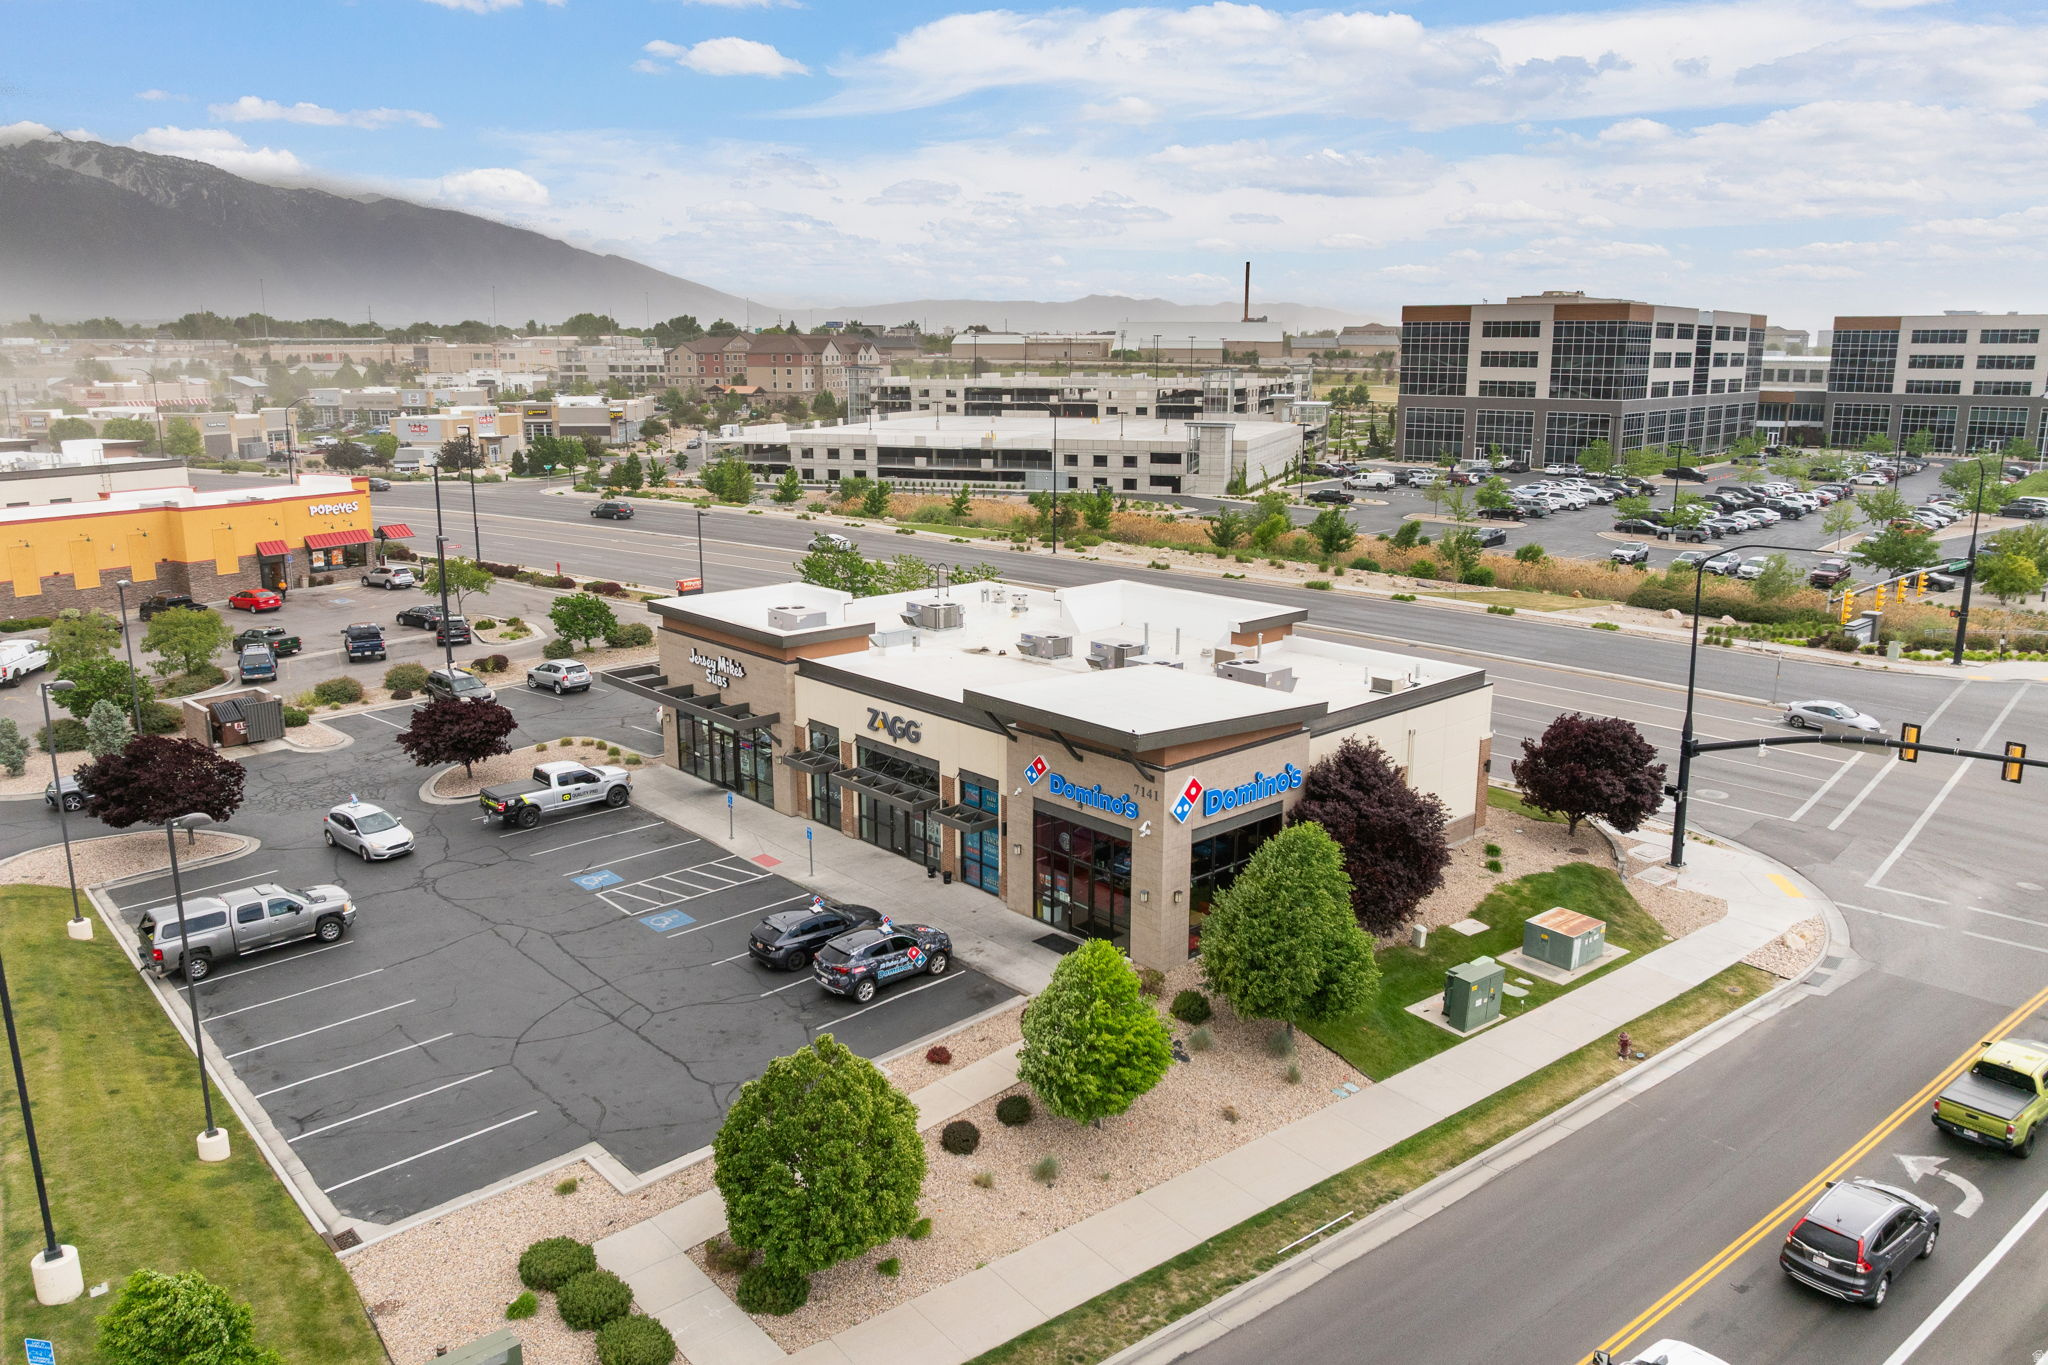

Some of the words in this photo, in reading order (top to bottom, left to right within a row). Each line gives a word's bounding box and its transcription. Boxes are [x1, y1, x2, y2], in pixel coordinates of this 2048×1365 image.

[309, 501, 359, 516] POPEYES
[689, 648, 717, 674] Jersey
[717, 656, 746, 678] Mike's
[867, 707, 922, 743] ZAGG
[1048, 772, 1139, 820] Domino's
[1133, 784, 1159, 801] 7141
[1203, 763, 1302, 817] Domino's
